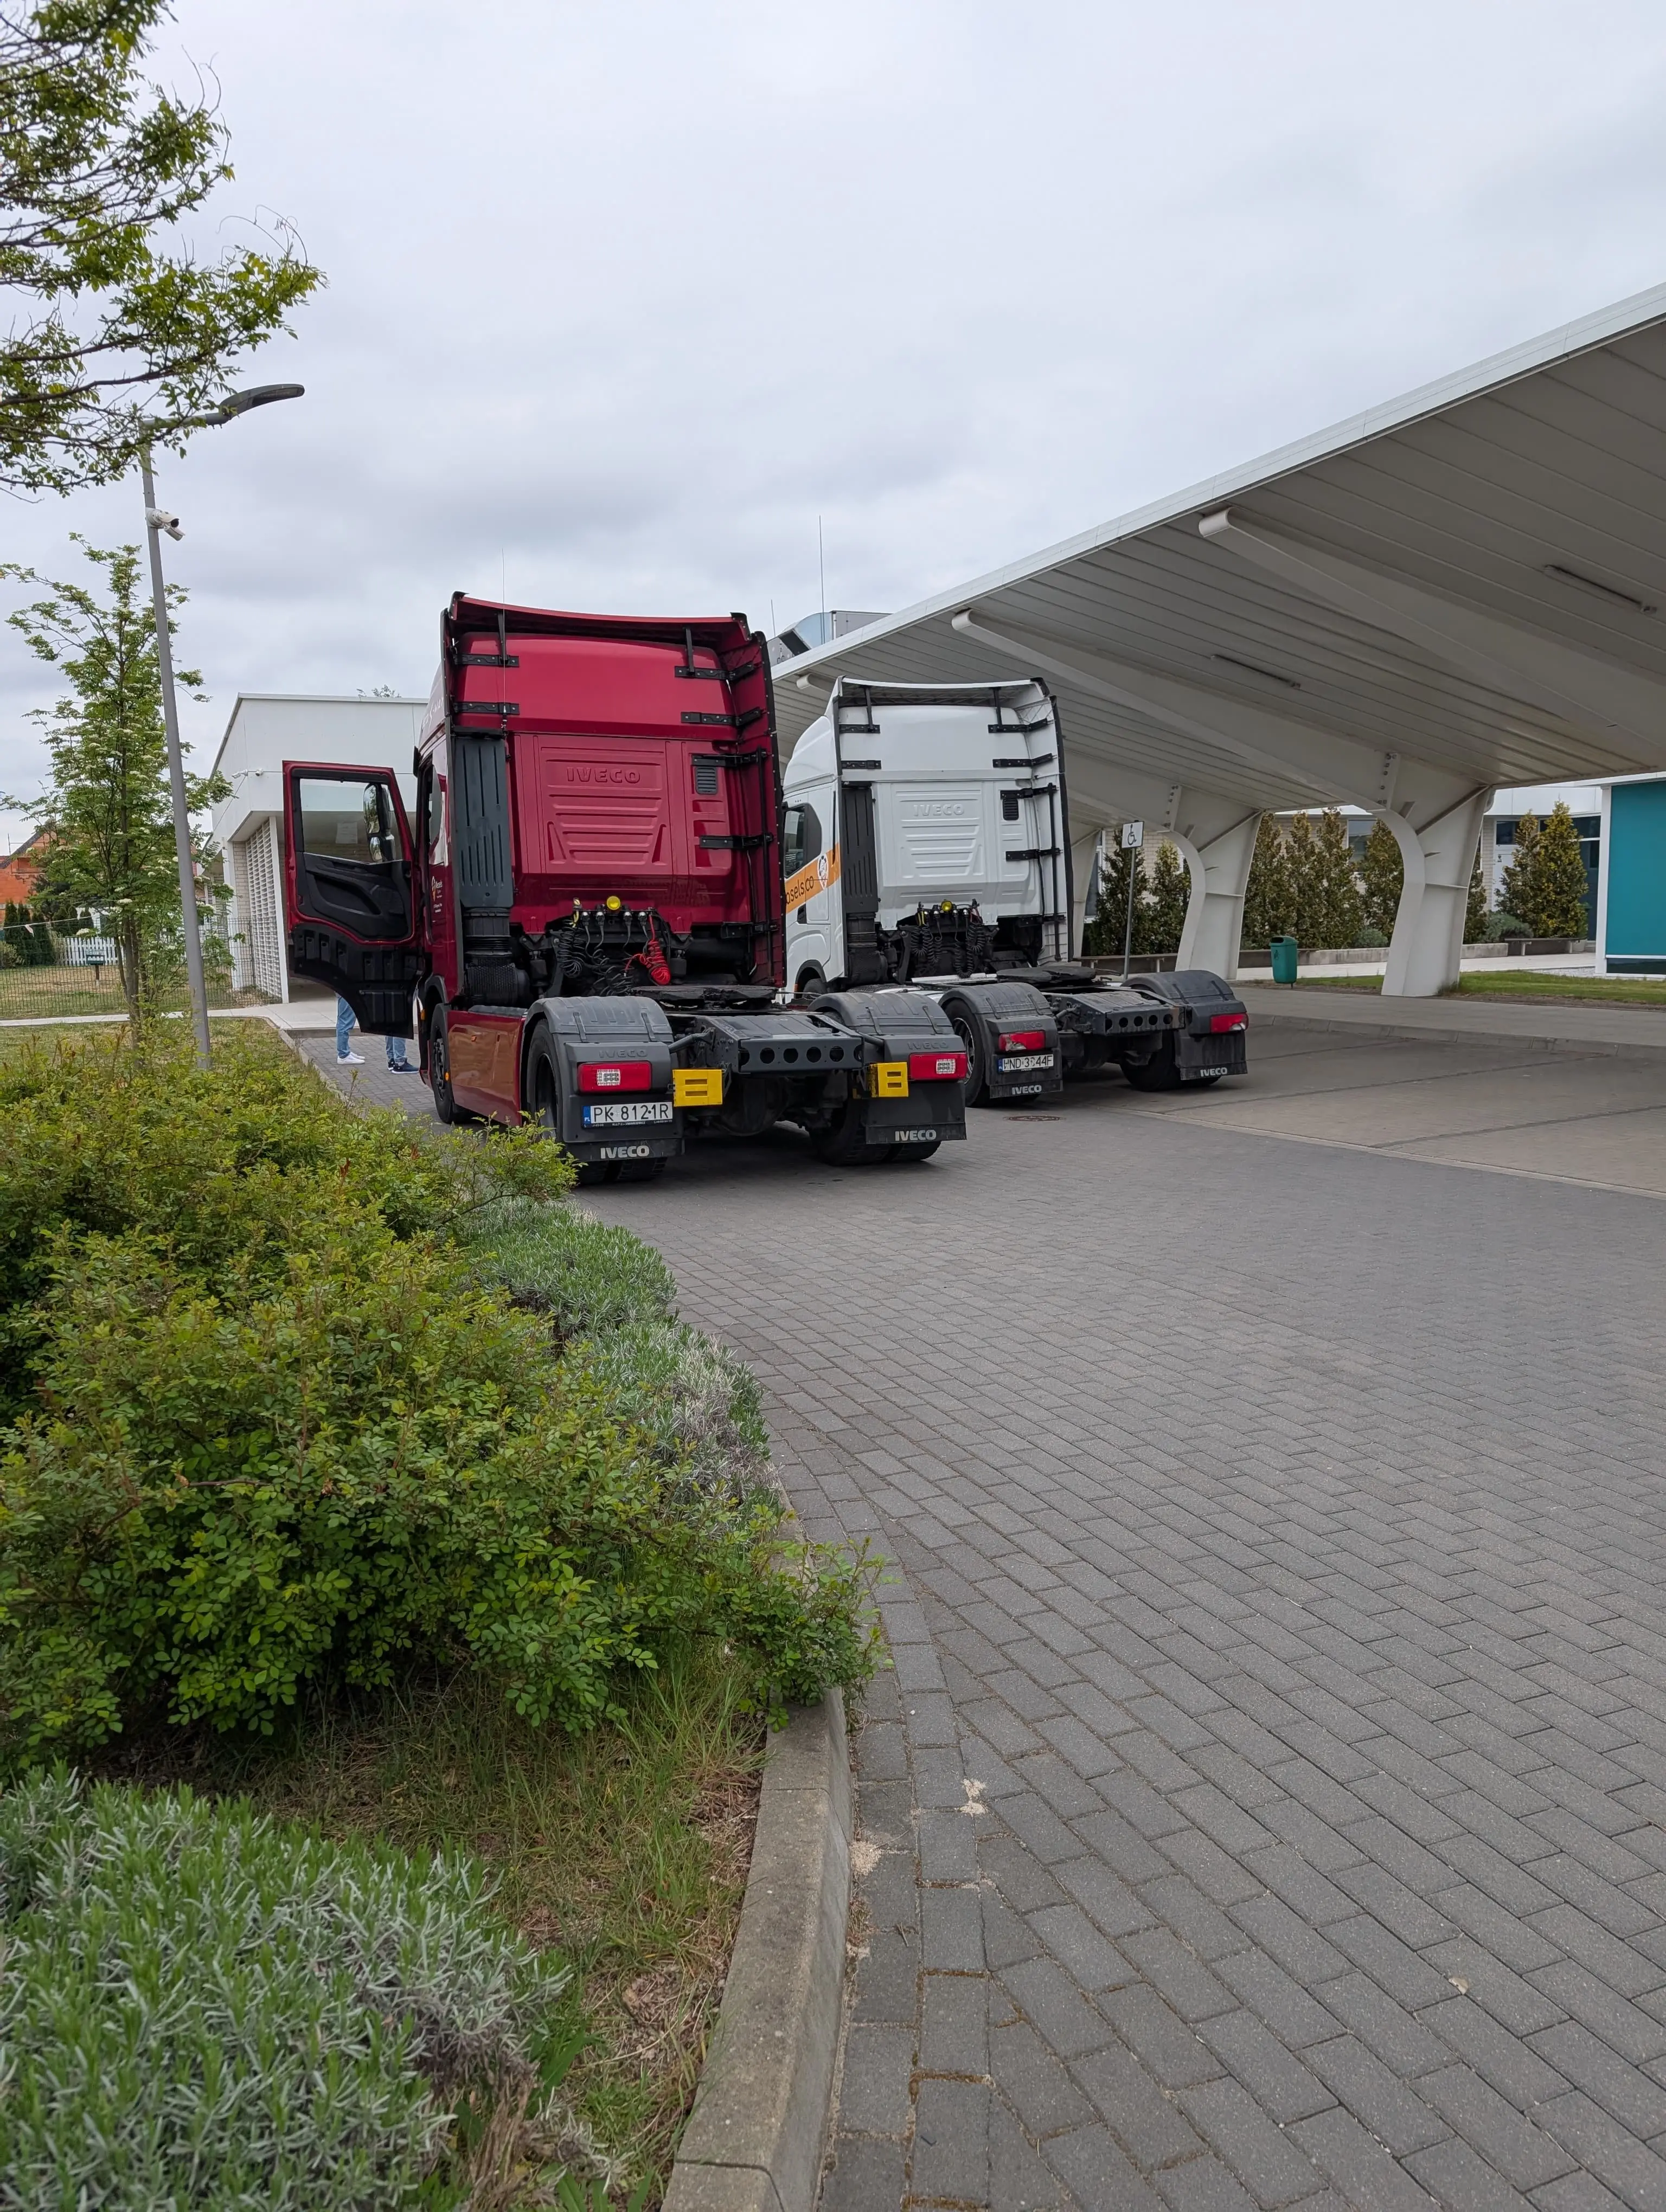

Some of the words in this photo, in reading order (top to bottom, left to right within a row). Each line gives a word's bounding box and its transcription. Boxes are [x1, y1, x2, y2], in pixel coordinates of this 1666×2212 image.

[567, 767, 640, 784] IVECO
[913, 803, 964, 816] IVECO
[907, 1041, 949, 1050] IVECO
[599, 1049, 648, 1058] IVECO
[1200, 1067, 1228, 1077] IVECO
[1011, 1084, 1042, 1095] IVECO
[593, 1106, 614, 1122] PK
[620, 1103, 669, 1121] 8121R
[895, 1129, 937, 1141] IVECO
[600, 1145, 650, 1159] IVECO
